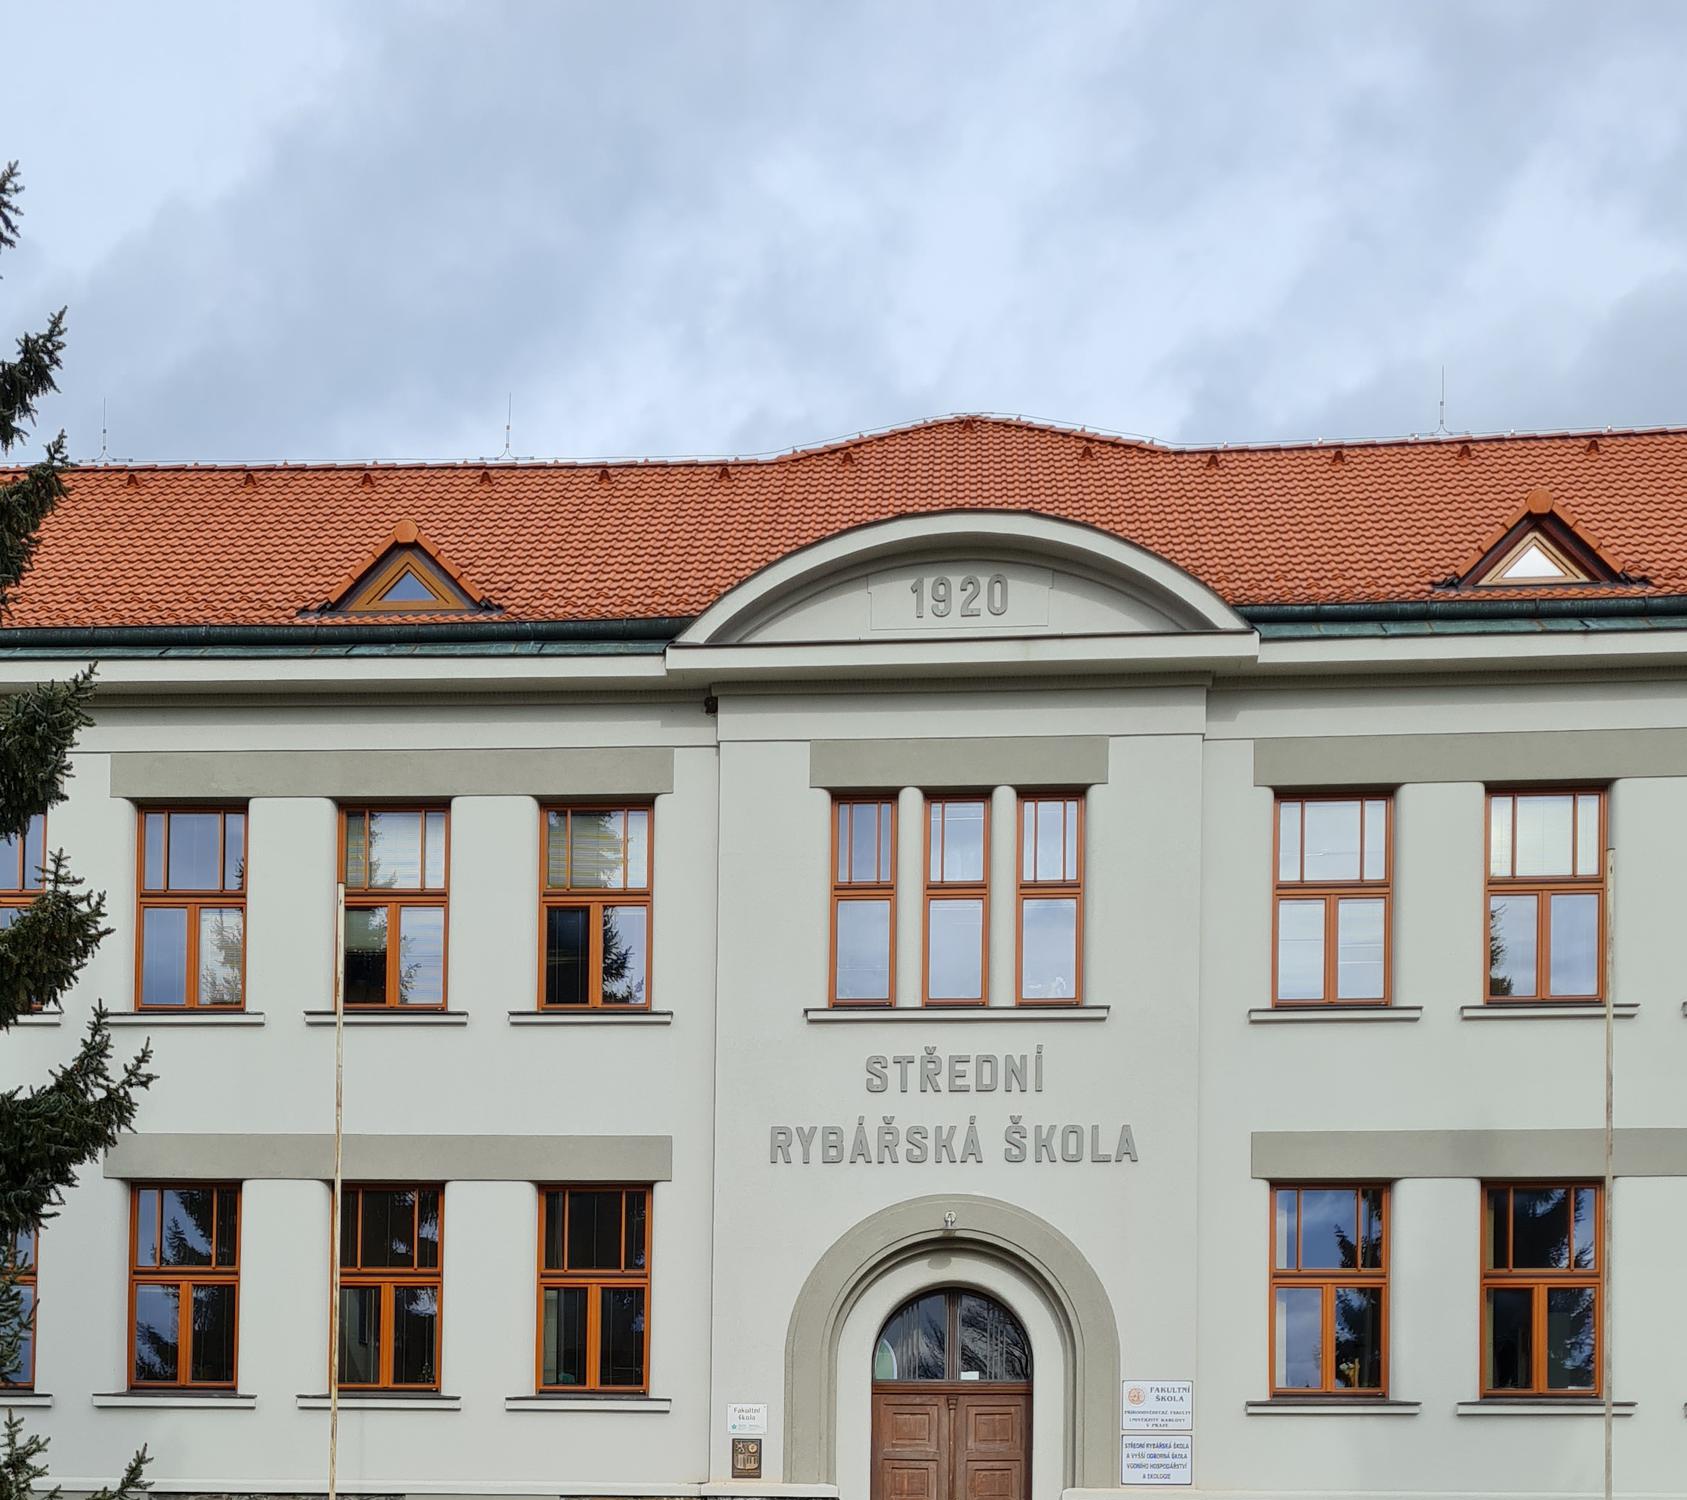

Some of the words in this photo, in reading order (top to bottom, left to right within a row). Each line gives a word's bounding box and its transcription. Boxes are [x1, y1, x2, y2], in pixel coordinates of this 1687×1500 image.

[910, 574, 1008, 618] 1920
[865, 1044, 1044, 1093] STŘEDNÍ
[770, 1115, 983, 1164] RYBÁŘSKÁ
[1004, 1114, 1139, 1163] ŠKOLA
[1150, 1385, 1190, 1394] FAKULTNÍ
[1155, 1394, 1184, 1402] ŠKOLA
